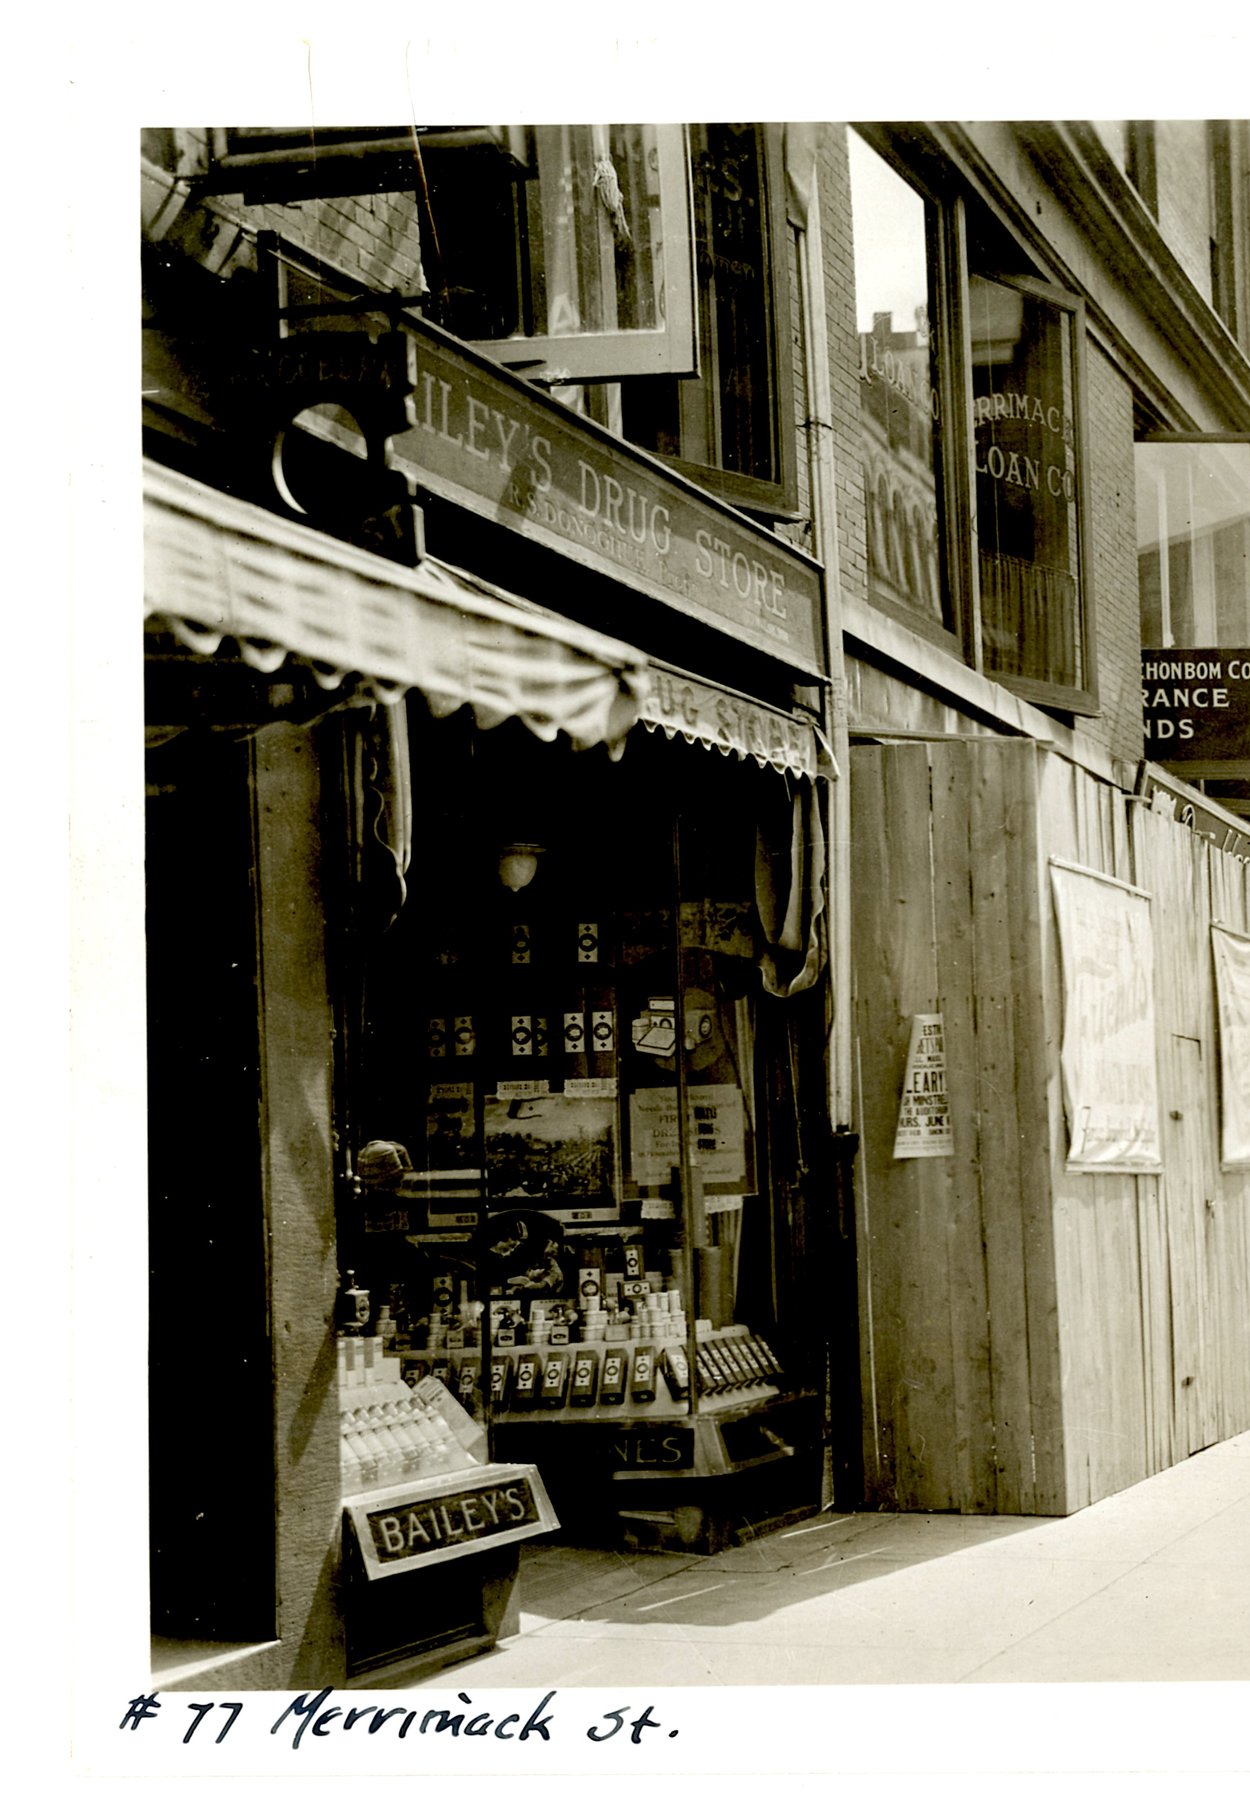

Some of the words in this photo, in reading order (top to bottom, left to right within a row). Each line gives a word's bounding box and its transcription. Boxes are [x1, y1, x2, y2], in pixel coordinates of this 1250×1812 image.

[422, 370, 552, 493] ILEY'S
[577, 459, 672, 555] DRUG
[695, 529, 787, 620] STORE
[1140, 662, 1221, 680] HONBOM
[378, 1487, 526, 1553] BAILEY'S
